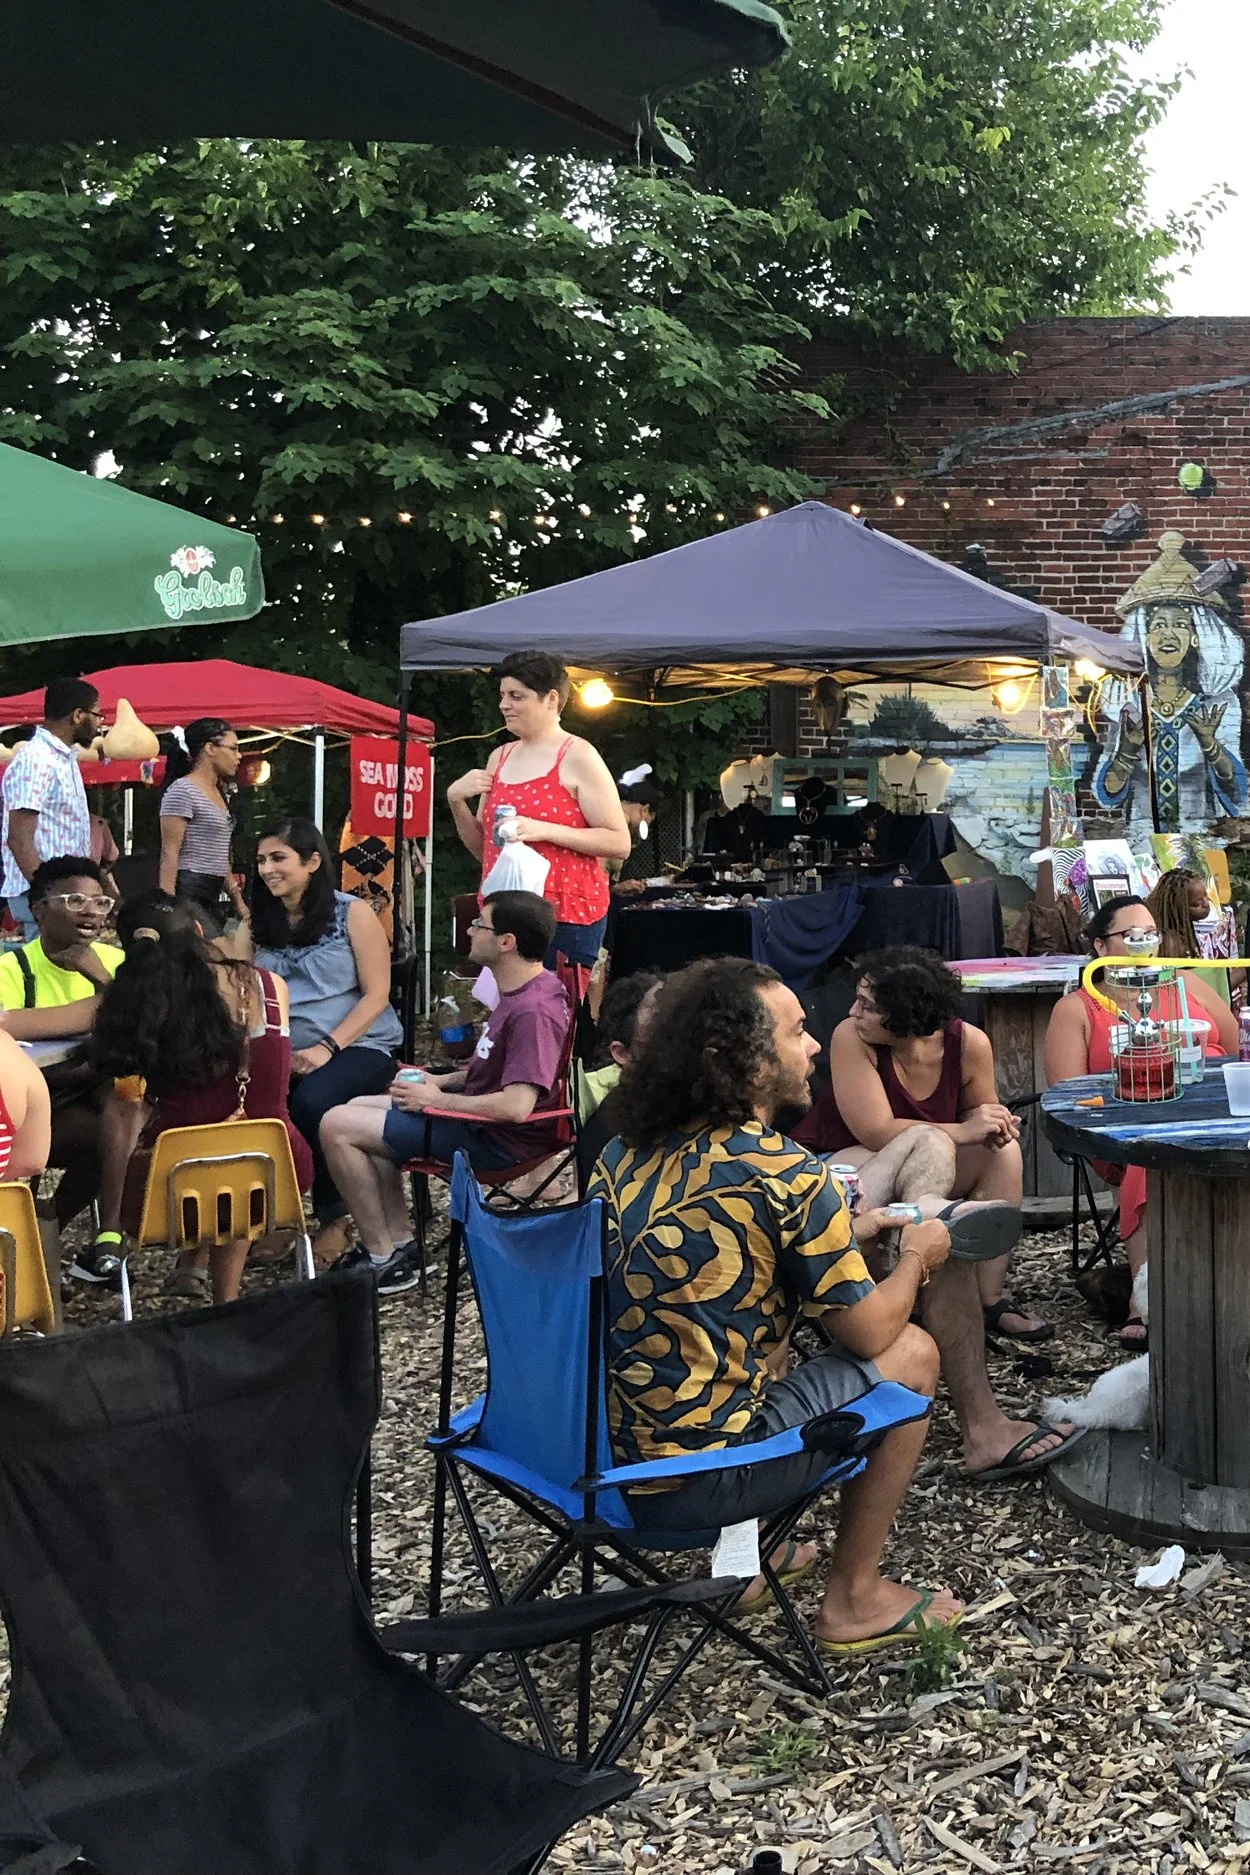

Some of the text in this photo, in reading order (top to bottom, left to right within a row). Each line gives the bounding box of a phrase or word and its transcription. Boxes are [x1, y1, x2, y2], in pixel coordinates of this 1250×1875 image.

[154, 566, 247, 620] Grolsch
[359, 759, 385, 785] SEA
[374, 791, 414, 819] GOD
